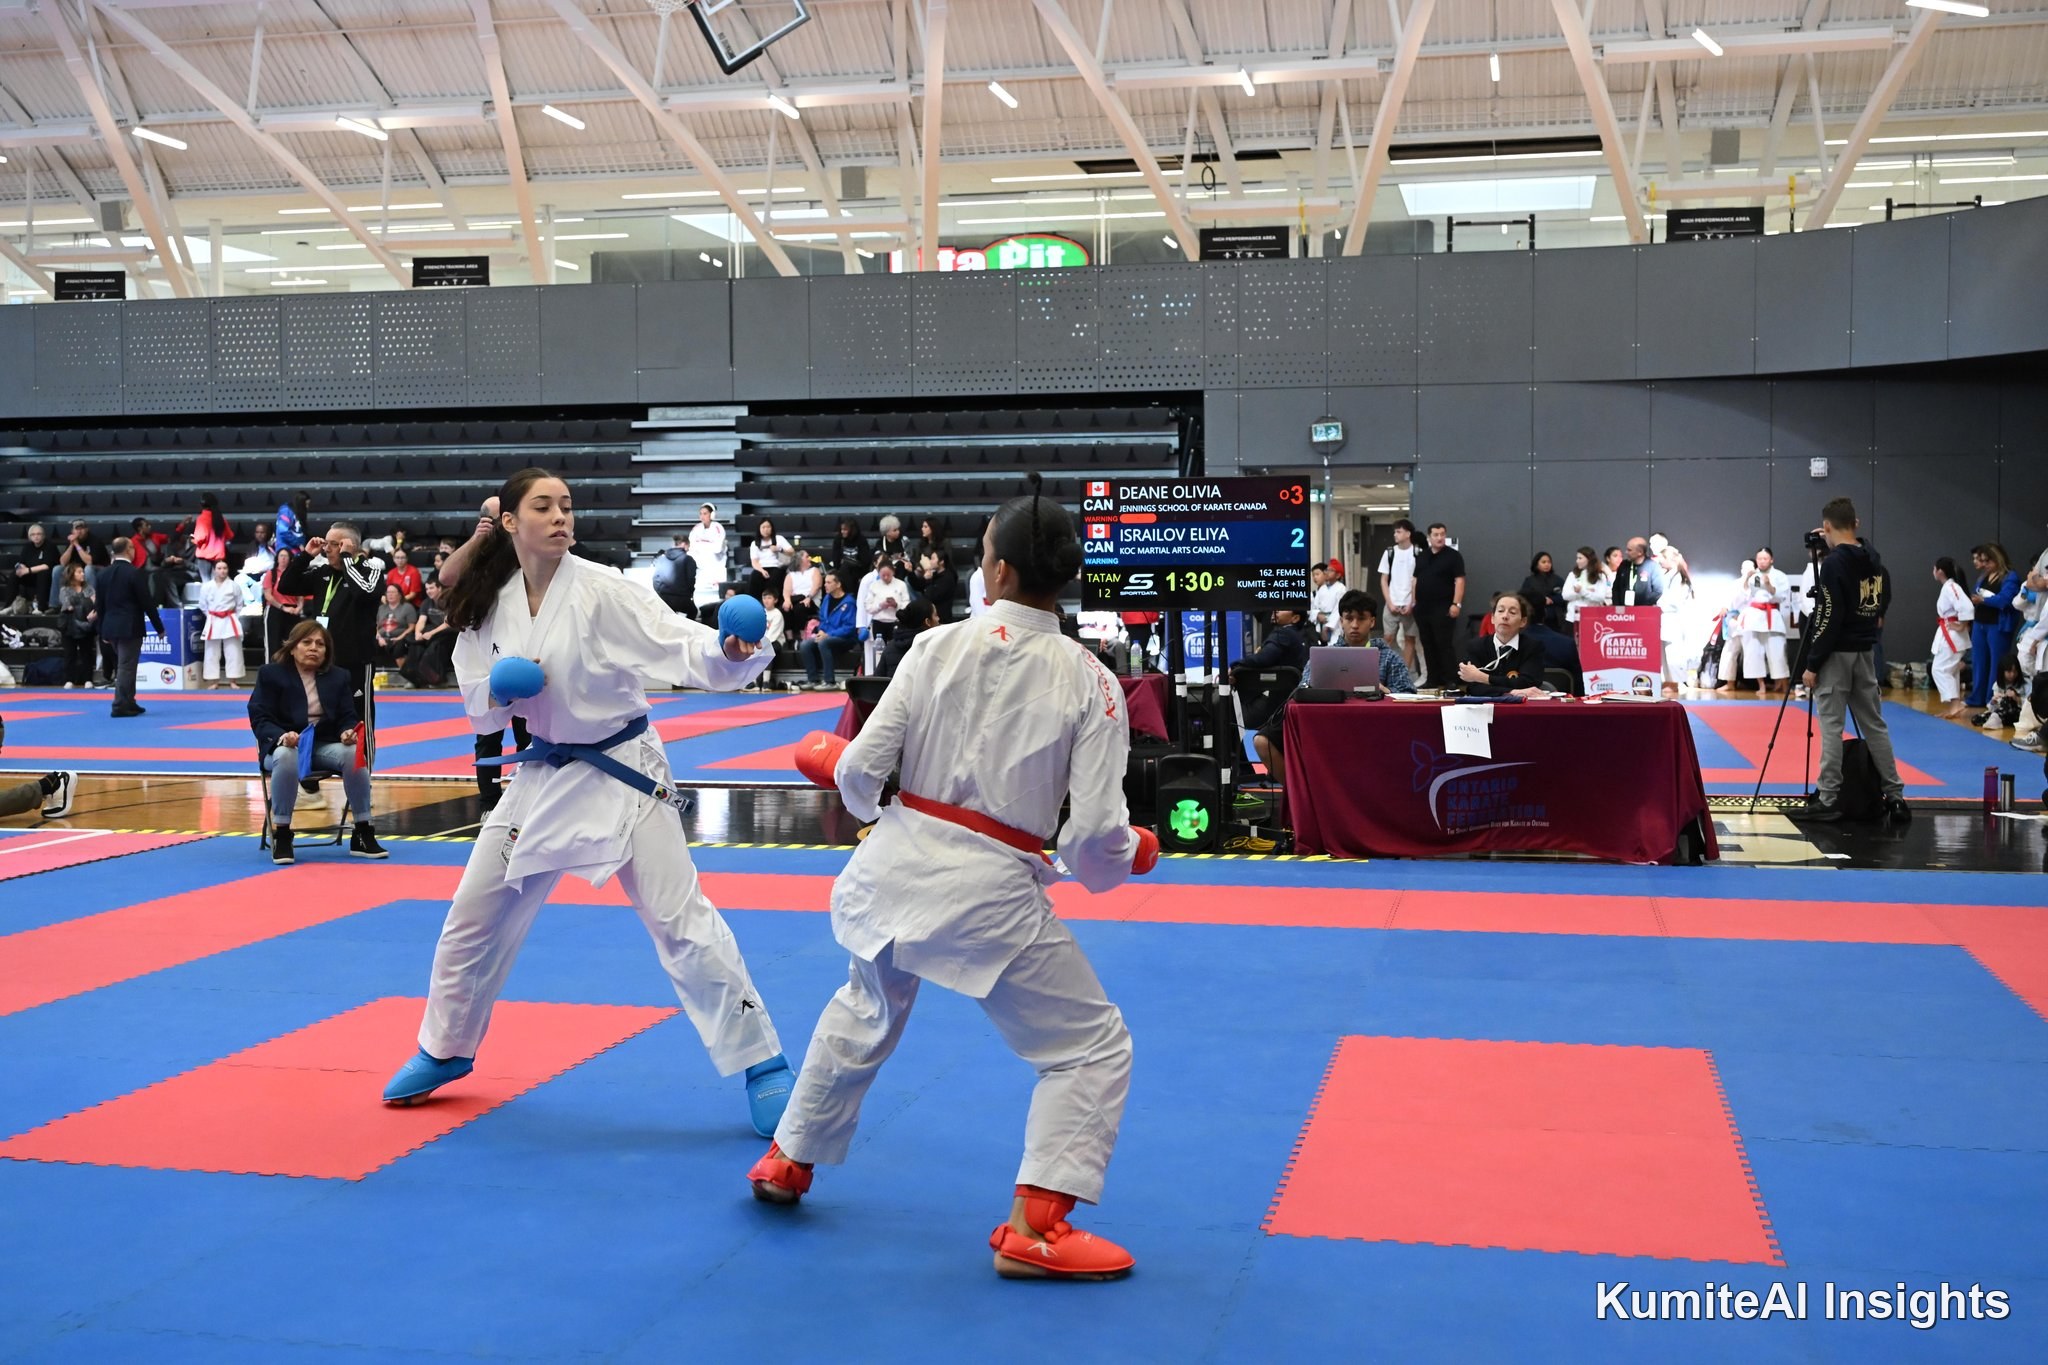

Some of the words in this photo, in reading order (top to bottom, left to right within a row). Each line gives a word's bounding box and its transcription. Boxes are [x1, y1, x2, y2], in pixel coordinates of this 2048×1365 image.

[999, 243, 1065, 270] Pit
[1120, 486, 1168, 499] DEANE
[1172, 485, 1221, 499] OLIVIA
[1083, 499, 1113, 511] CAN
[1158, 504, 1189, 512] SCHOOL
[1191, 503, 1201, 511] OF
[1203, 503, 1232, 511] KARATE
[1233, 502, 1267, 510] CANADA
[1120, 528, 1186, 542] ISRAILOV
[1190, 527, 1229, 541] ELIYA
[1291, 527, 1305, 547] 2
[1084, 541, 1114, 553] CAN
[1172, 546, 1191, 554] ARTS
[1237, 580, 1266, 588] KUMITE
[1104, 588, 1111, 598] 2
[1189, 614, 1217, 622] COAH
[1606, 614, 1635, 622] COACH
[1815, 604, 1823, 627] CENTRE
[1606, 638, 1643, 647] KARATE
[141, 644, 171, 652] ONTARIO
[1606, 647, 1647, 656] ONTARIO
[1454, 725, 1480, 733] TATAMI
[1447, 777, 1518, 794] ONTARIO
[1447, 793, 1510, 810] KARATE
